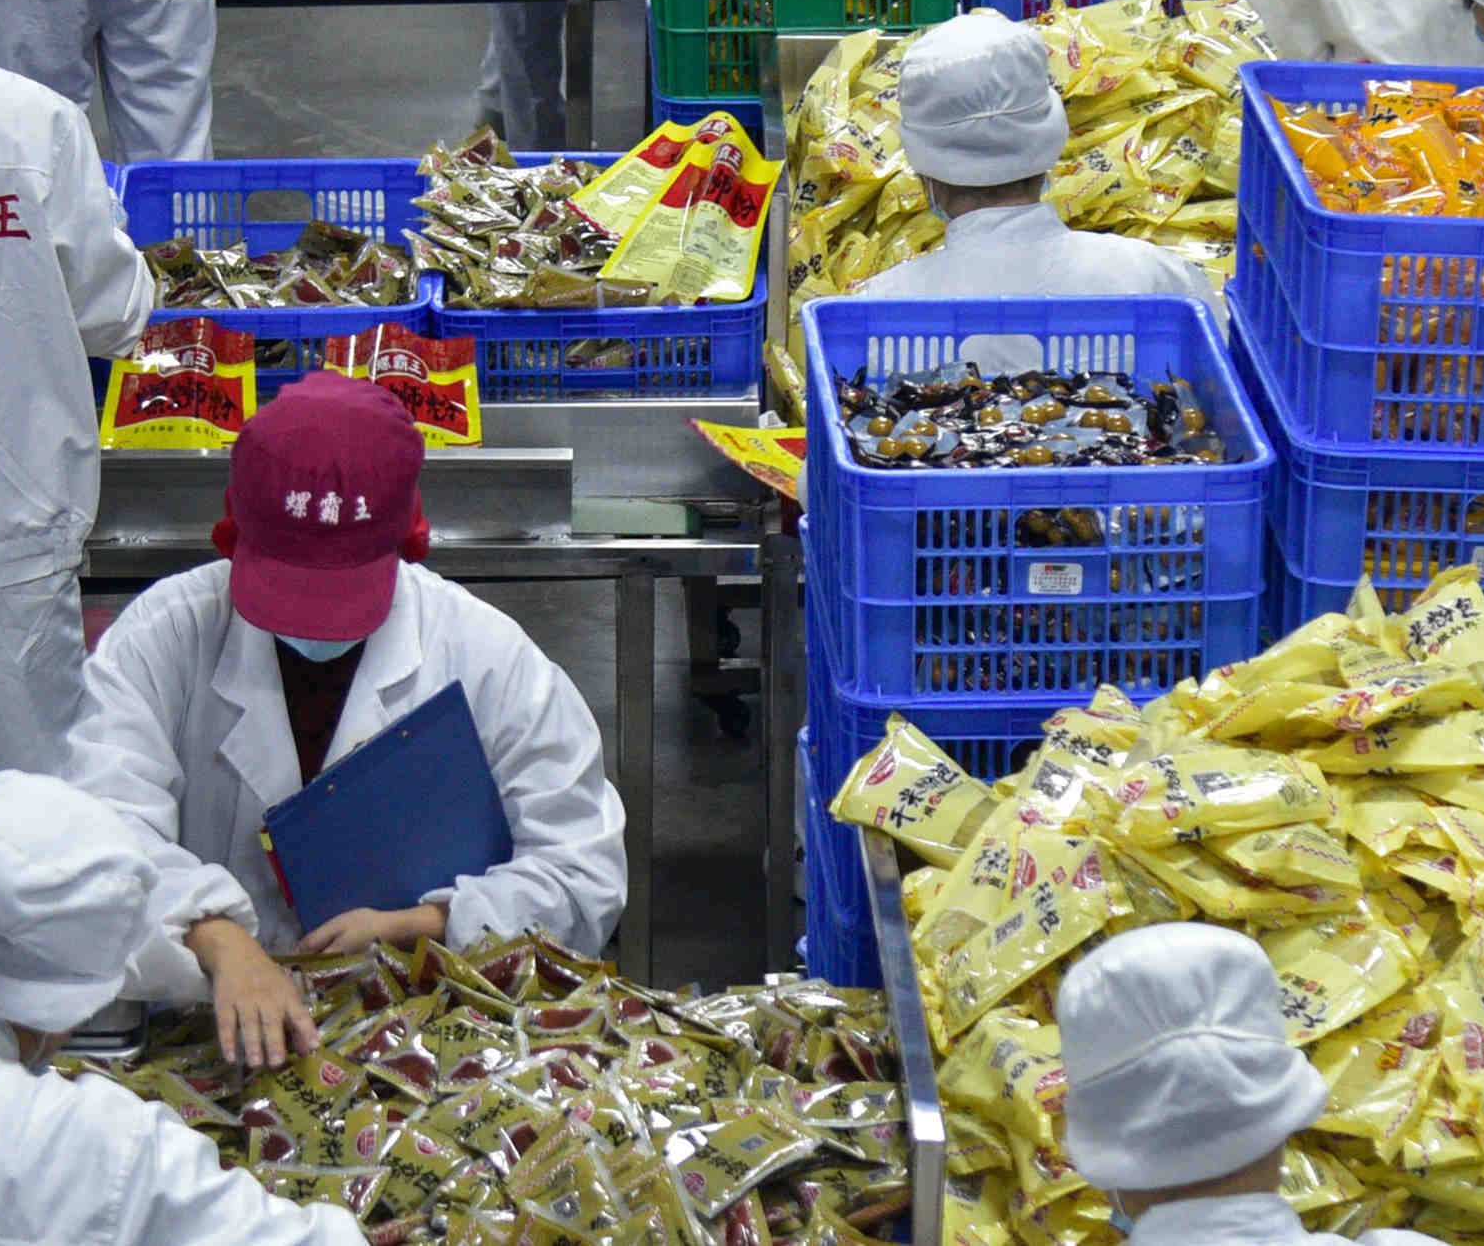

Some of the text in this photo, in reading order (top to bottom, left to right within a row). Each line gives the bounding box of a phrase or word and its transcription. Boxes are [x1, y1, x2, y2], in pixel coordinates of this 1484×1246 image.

[376, 355, 424, 375] 螺霸王
[284, 489, 373, 526] 螺霸王
